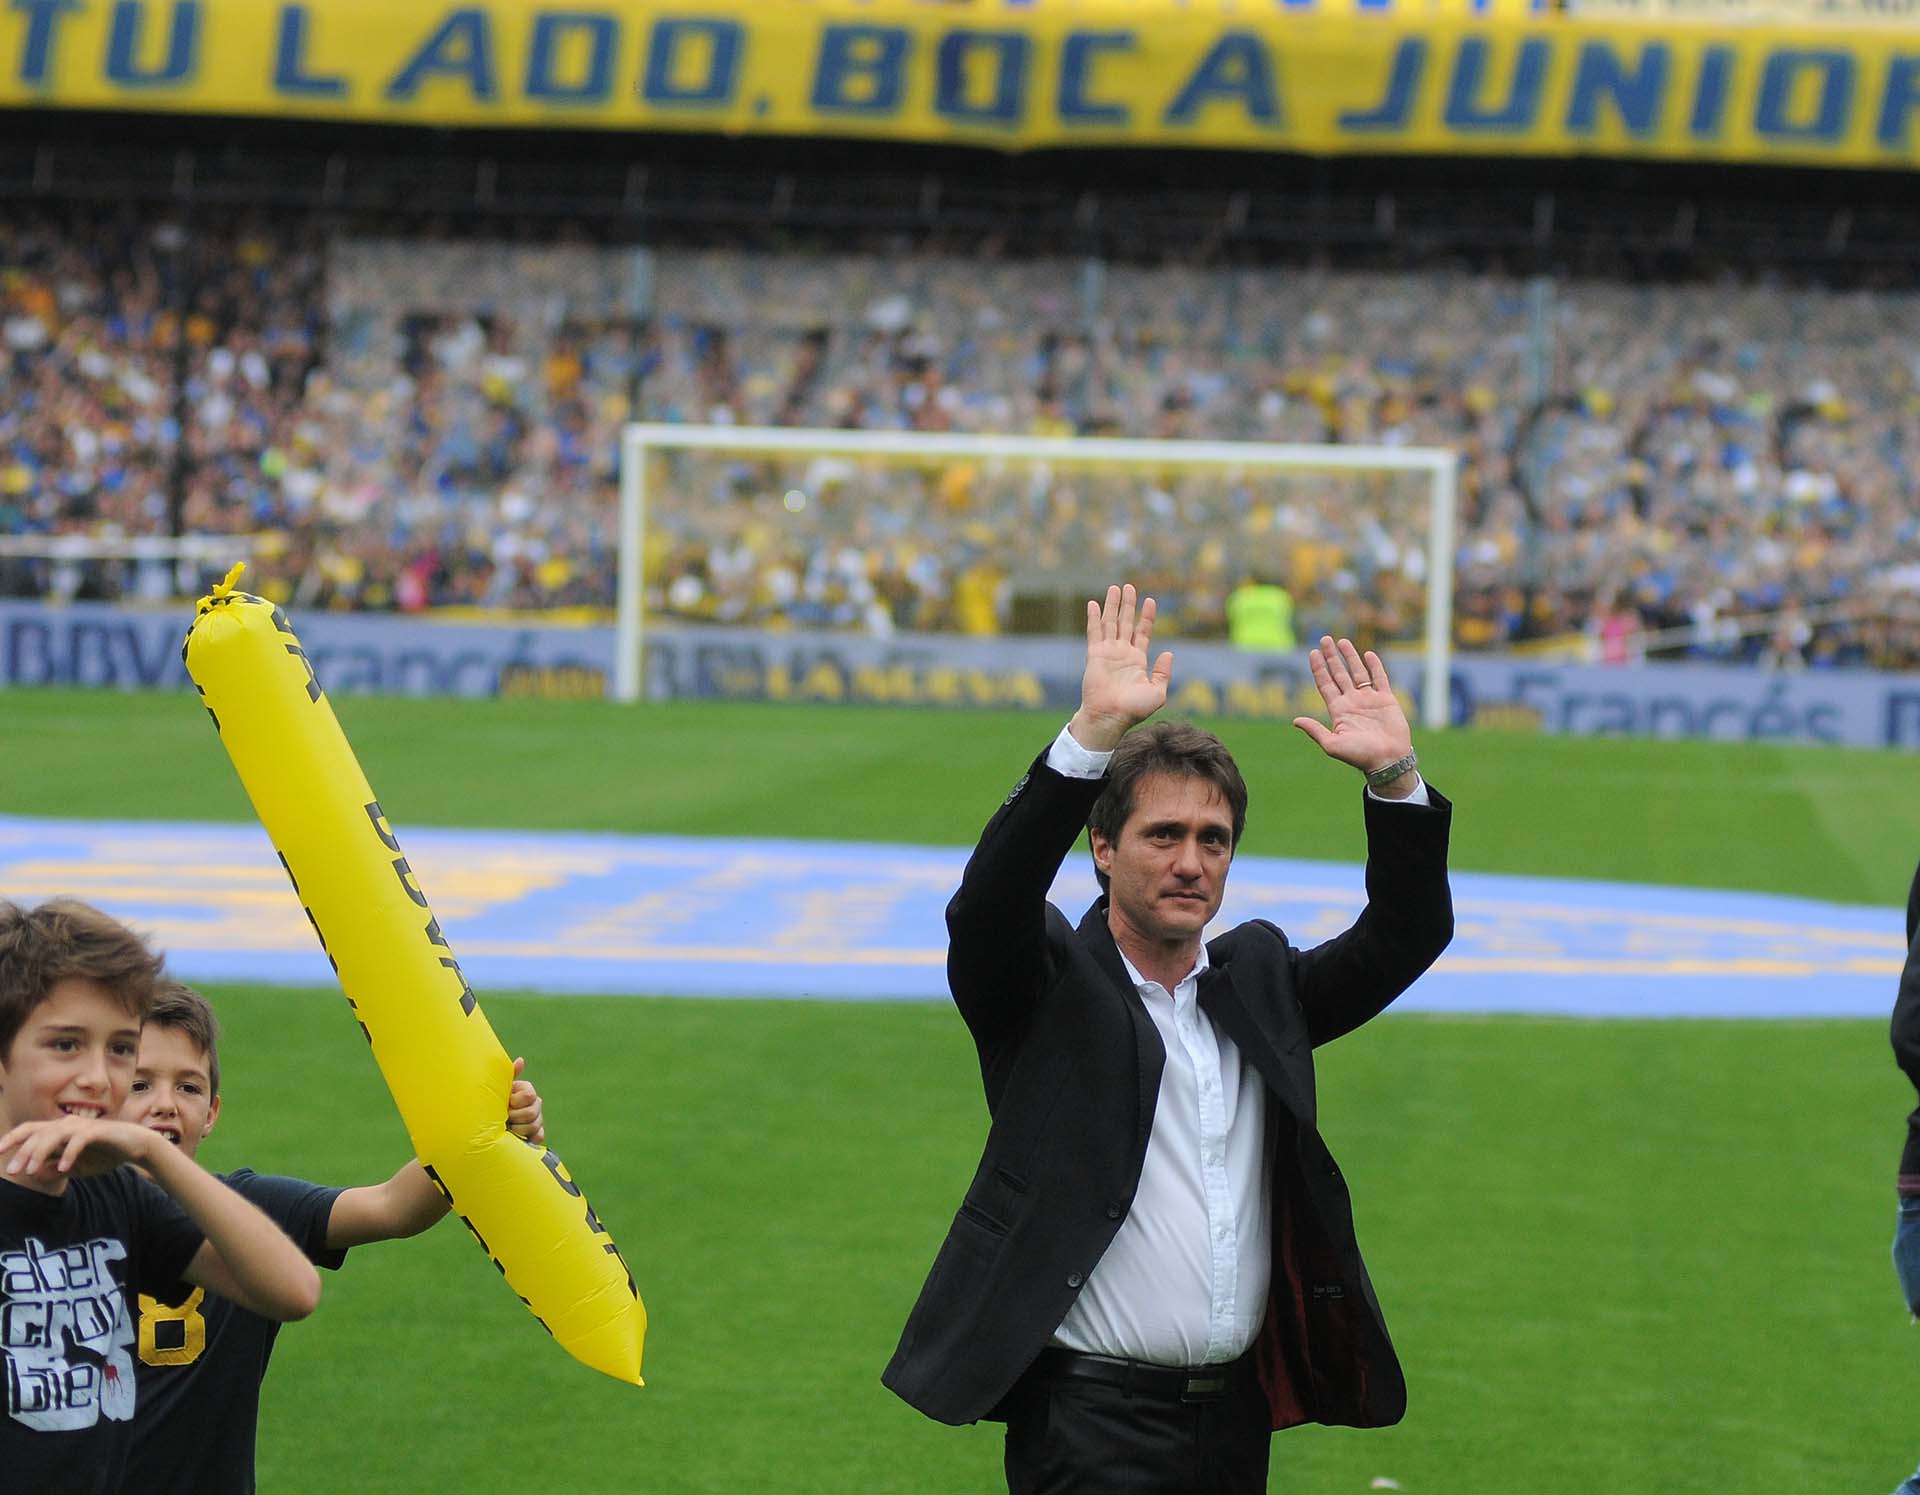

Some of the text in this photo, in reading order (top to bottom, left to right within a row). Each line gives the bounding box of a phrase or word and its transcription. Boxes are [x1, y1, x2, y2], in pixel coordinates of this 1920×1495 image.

[10, 0, 200, 88] TU
[809, 22, 1285, 128] BOCA
[2, 1238, 126, 1294] aber
